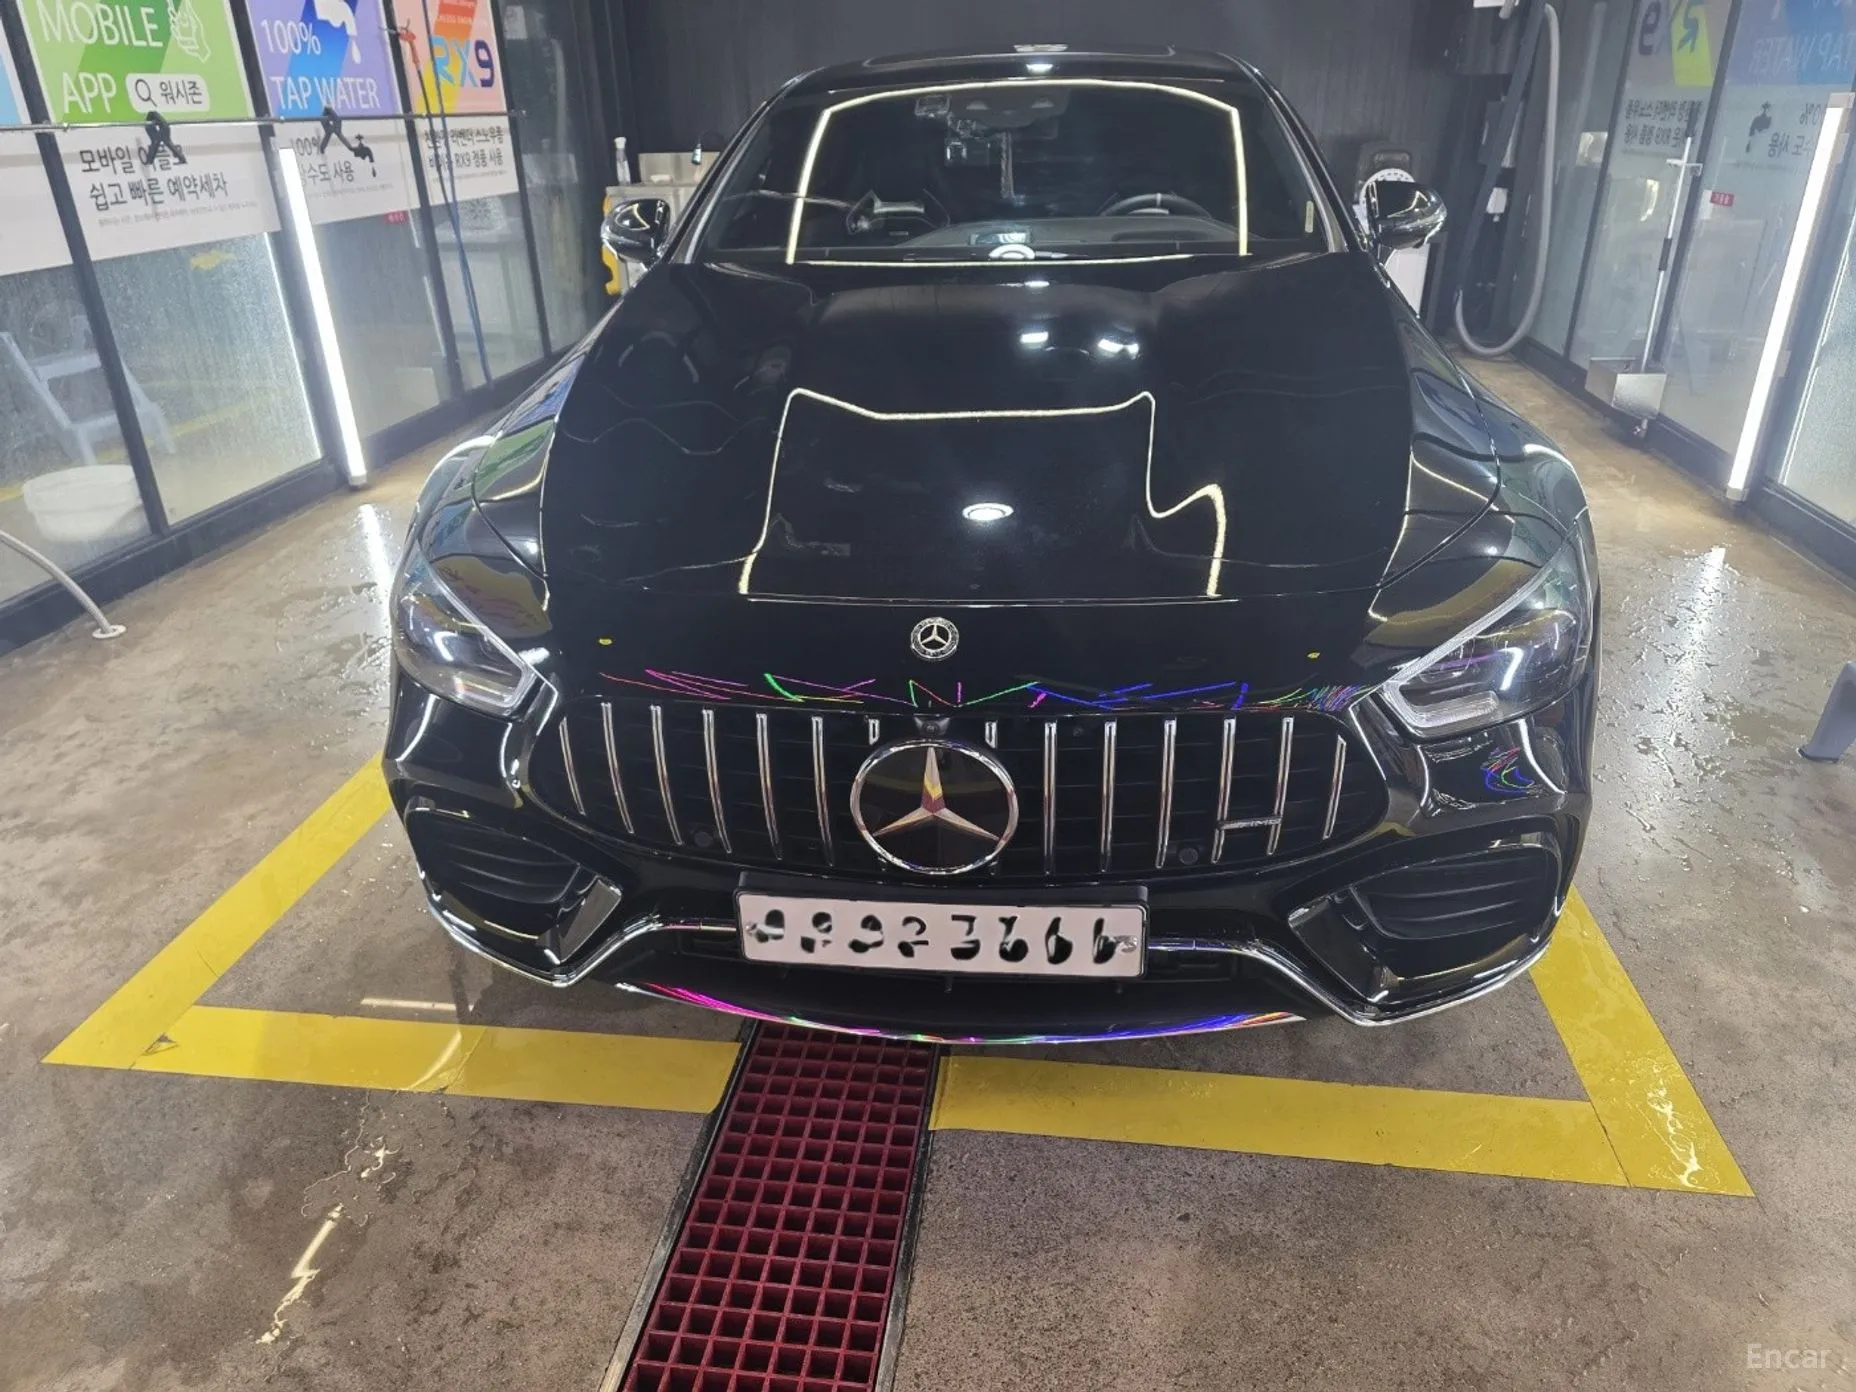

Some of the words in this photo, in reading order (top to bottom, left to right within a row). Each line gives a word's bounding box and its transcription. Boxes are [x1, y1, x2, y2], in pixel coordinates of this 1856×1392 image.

[36, 0, 163, 48] MOBILE
[260, 18, 322, 56] 100%
[431, 35, 495, 88] RX9
[61, 72, 117, 114] APP
[160, 79, 203, 105] 워시존
[270, 76, 312, 110] TAP
[316, 76, 382, 110] WATER
[80, 144, 135, 175] 모바일
[333, 160, 355, 184] 사용
[90, 181, 127, 212] 쉽고
[128, 177, 165, 206] 빠른
[166, 171, 229, 202] 예약세차
